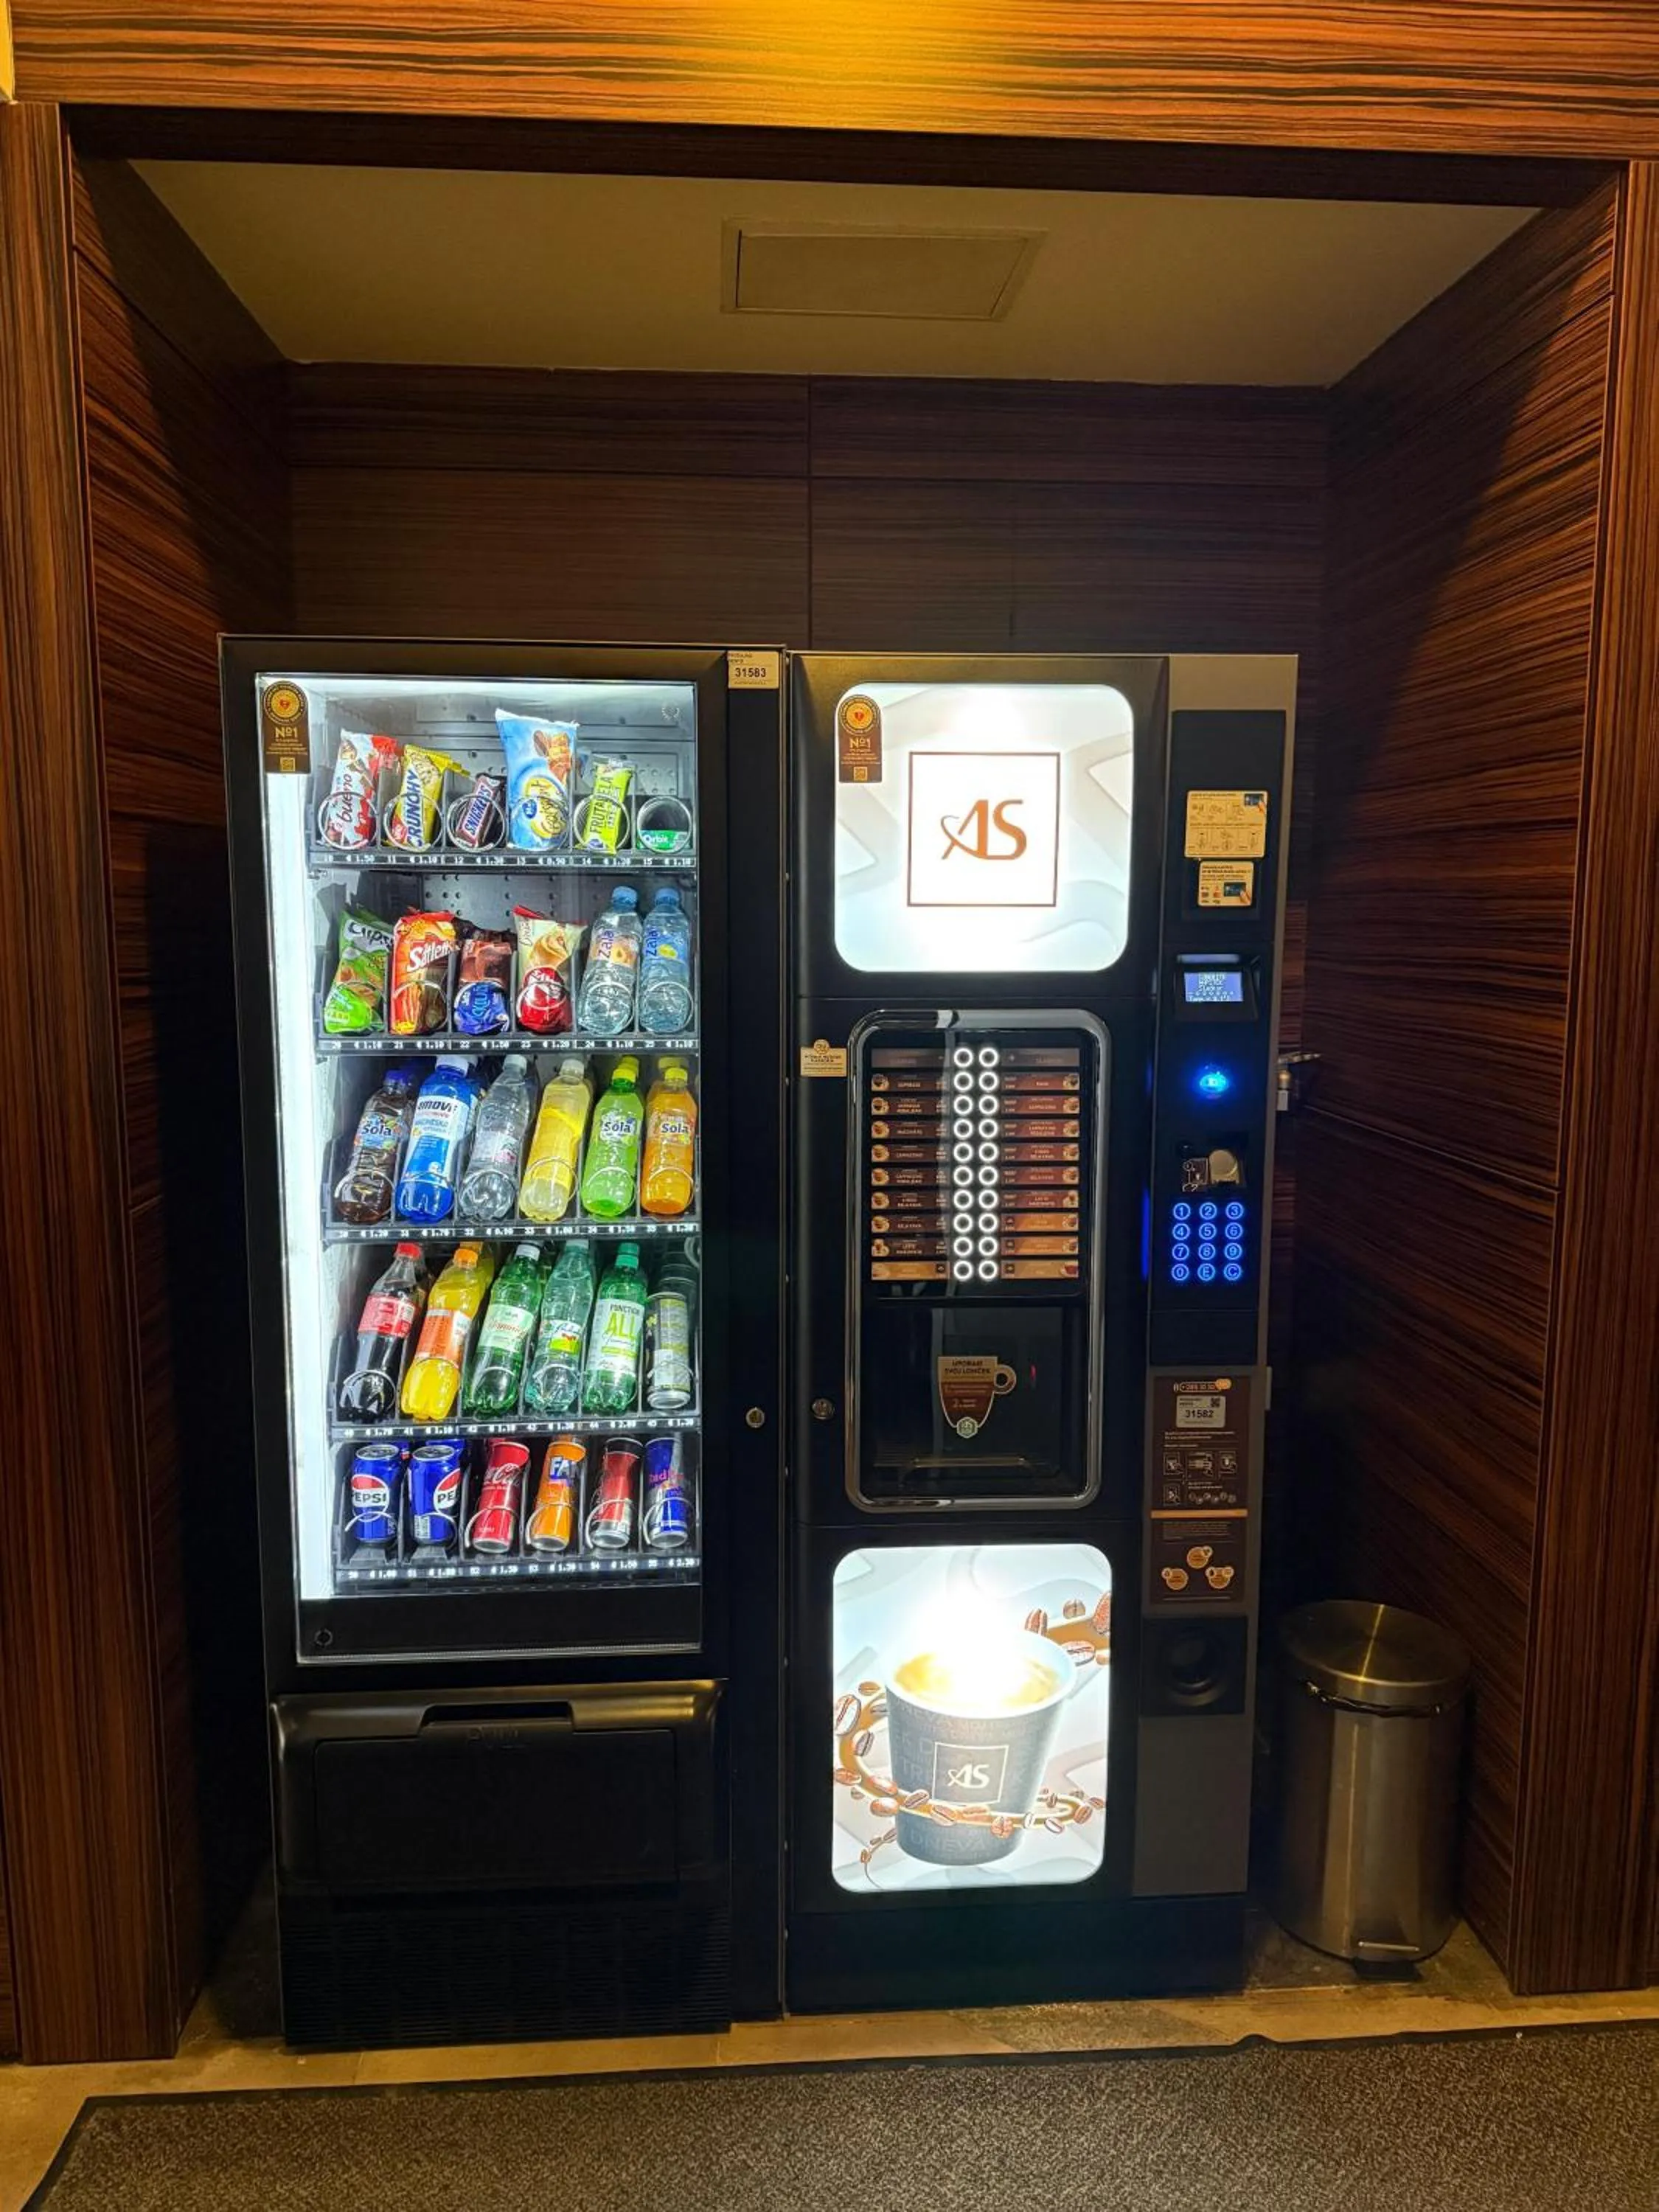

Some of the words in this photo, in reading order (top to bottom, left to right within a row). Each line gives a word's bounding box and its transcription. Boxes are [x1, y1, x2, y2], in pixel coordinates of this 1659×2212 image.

[734, 668, 767, 678] 31583
[455, 856, 463, 864] 12
[460, 1040, 470, 1048] 22
[361, 1124, 392, 1136] Sola
[604, 1121, 630, 1133] Sola
[661, 1122, 689, 1133] Sola
[1204, 1206, 1211, 1216] 2
[1231, 1206, 1238, 1216] 3
[1177, 1227, 1184, 1237] 4
[1203, 1227, 1211, 1237] 5
[1230, 1226, 1237, 1236] 6
[1203, 1247, 1211, 1256] 8
[1229, 1246, 1237, 1256] 9
[1176, 1267, 1184, 1277] 0
[1203, 1267, 1210, 1276] E
[1228, 1267, 1237, 1276] C
[1184, 1409, 1214, 1419] 31582
[352, 1492, 387, 1503] EPSI
